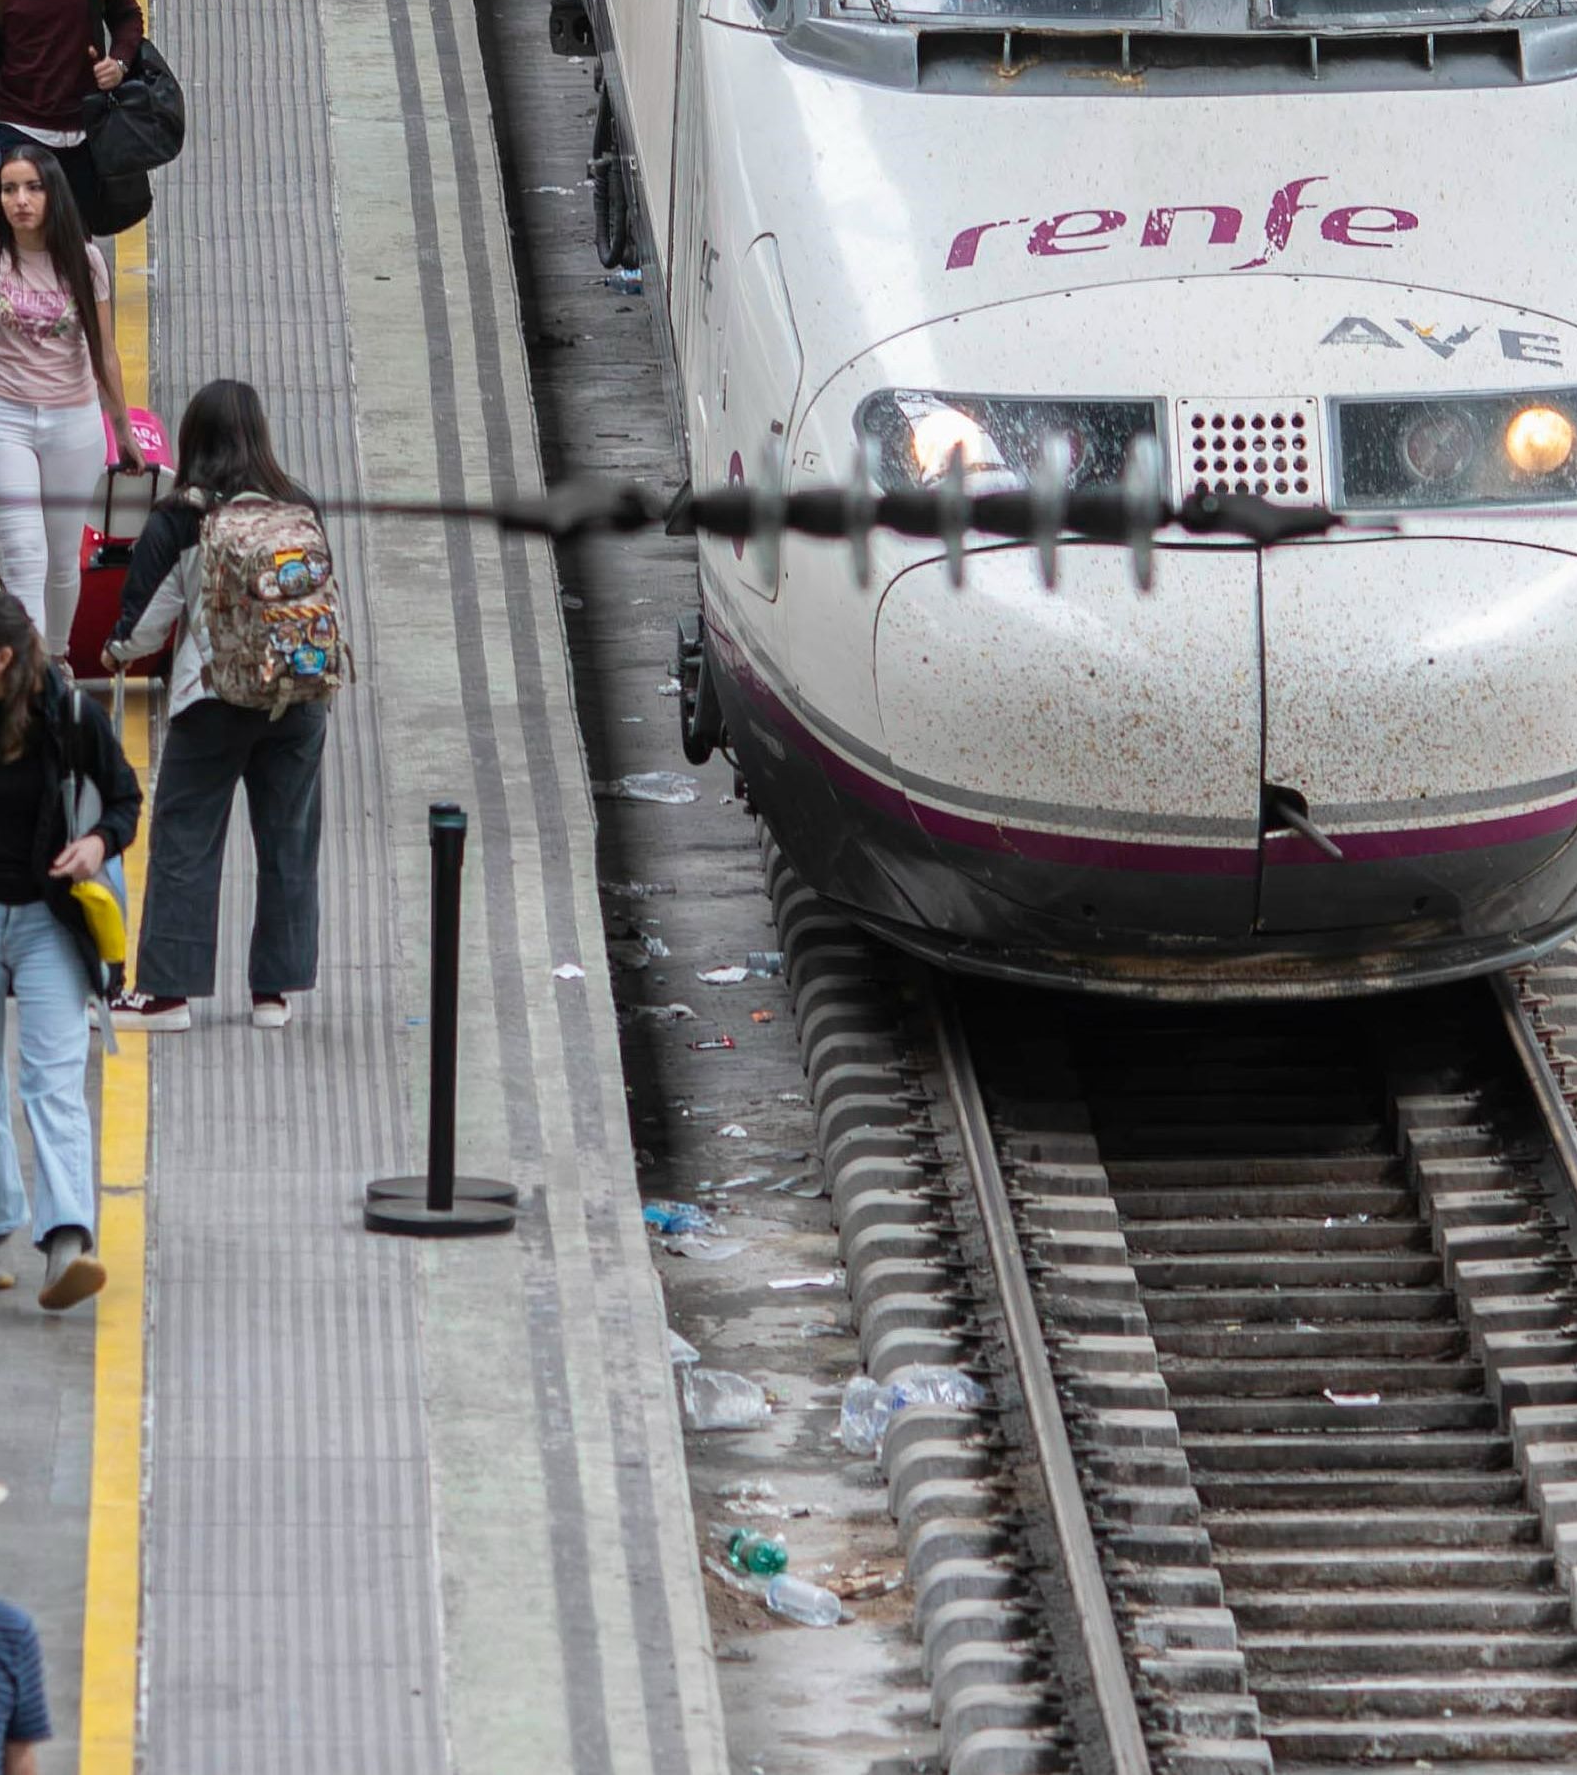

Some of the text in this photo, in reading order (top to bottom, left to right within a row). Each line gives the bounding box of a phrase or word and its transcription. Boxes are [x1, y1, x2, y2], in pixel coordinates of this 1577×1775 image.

[945, 176, 1419, 271] renfe
[11, 289, 66, 308] GUESS
[1318, 316, 1564, 369] AVE
